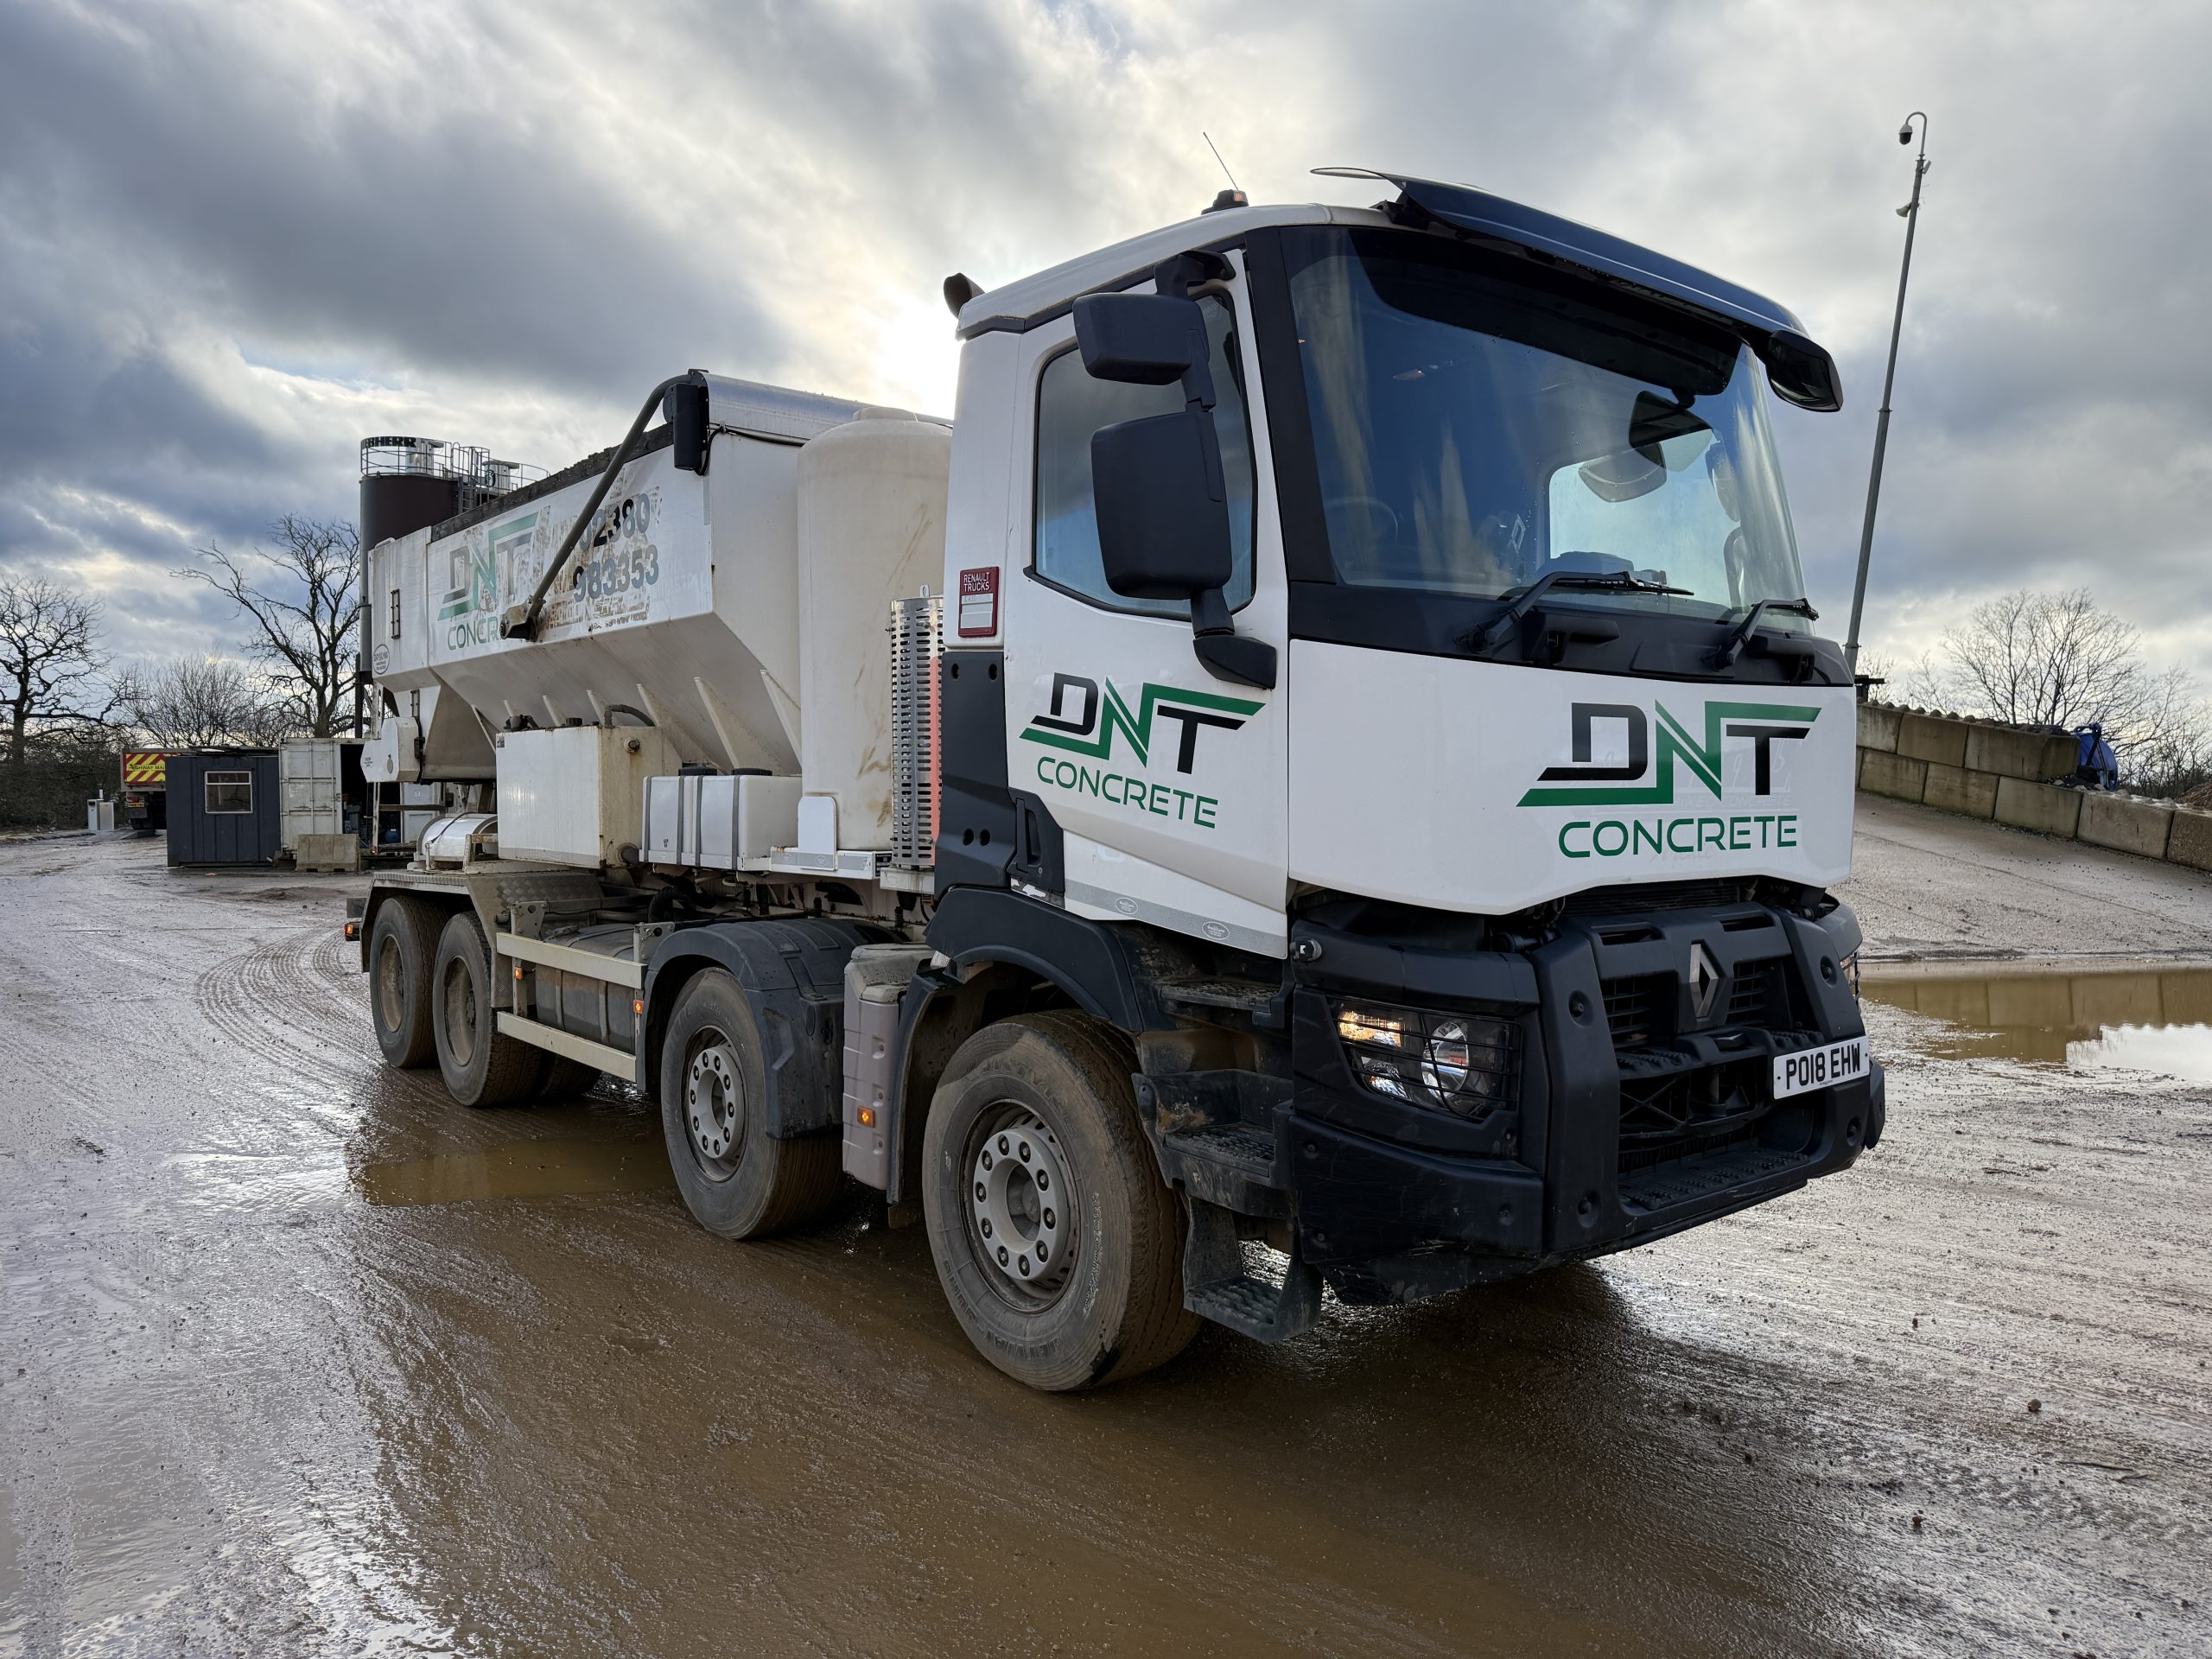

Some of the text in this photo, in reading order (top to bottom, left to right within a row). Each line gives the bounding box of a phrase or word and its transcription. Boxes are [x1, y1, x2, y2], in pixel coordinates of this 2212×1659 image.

[361, 436, 416, 448] EBHERR
[437, 512, 539, 620] DNT
[963, 572, 990, 583] RENAULT
[963, 582, 990, 593] TRUCKS
[448, 616, 499, 651] CONCR
[1019, 672, 1266, 774] DNT
[1516, 699, 1822, 807] DNT
[1037, 756, 1218, 830] CONCRETE
[1558, 815, 1797, 858] CONCRETE
[1786, 1042, 1860, 1090] PO18 EHW
